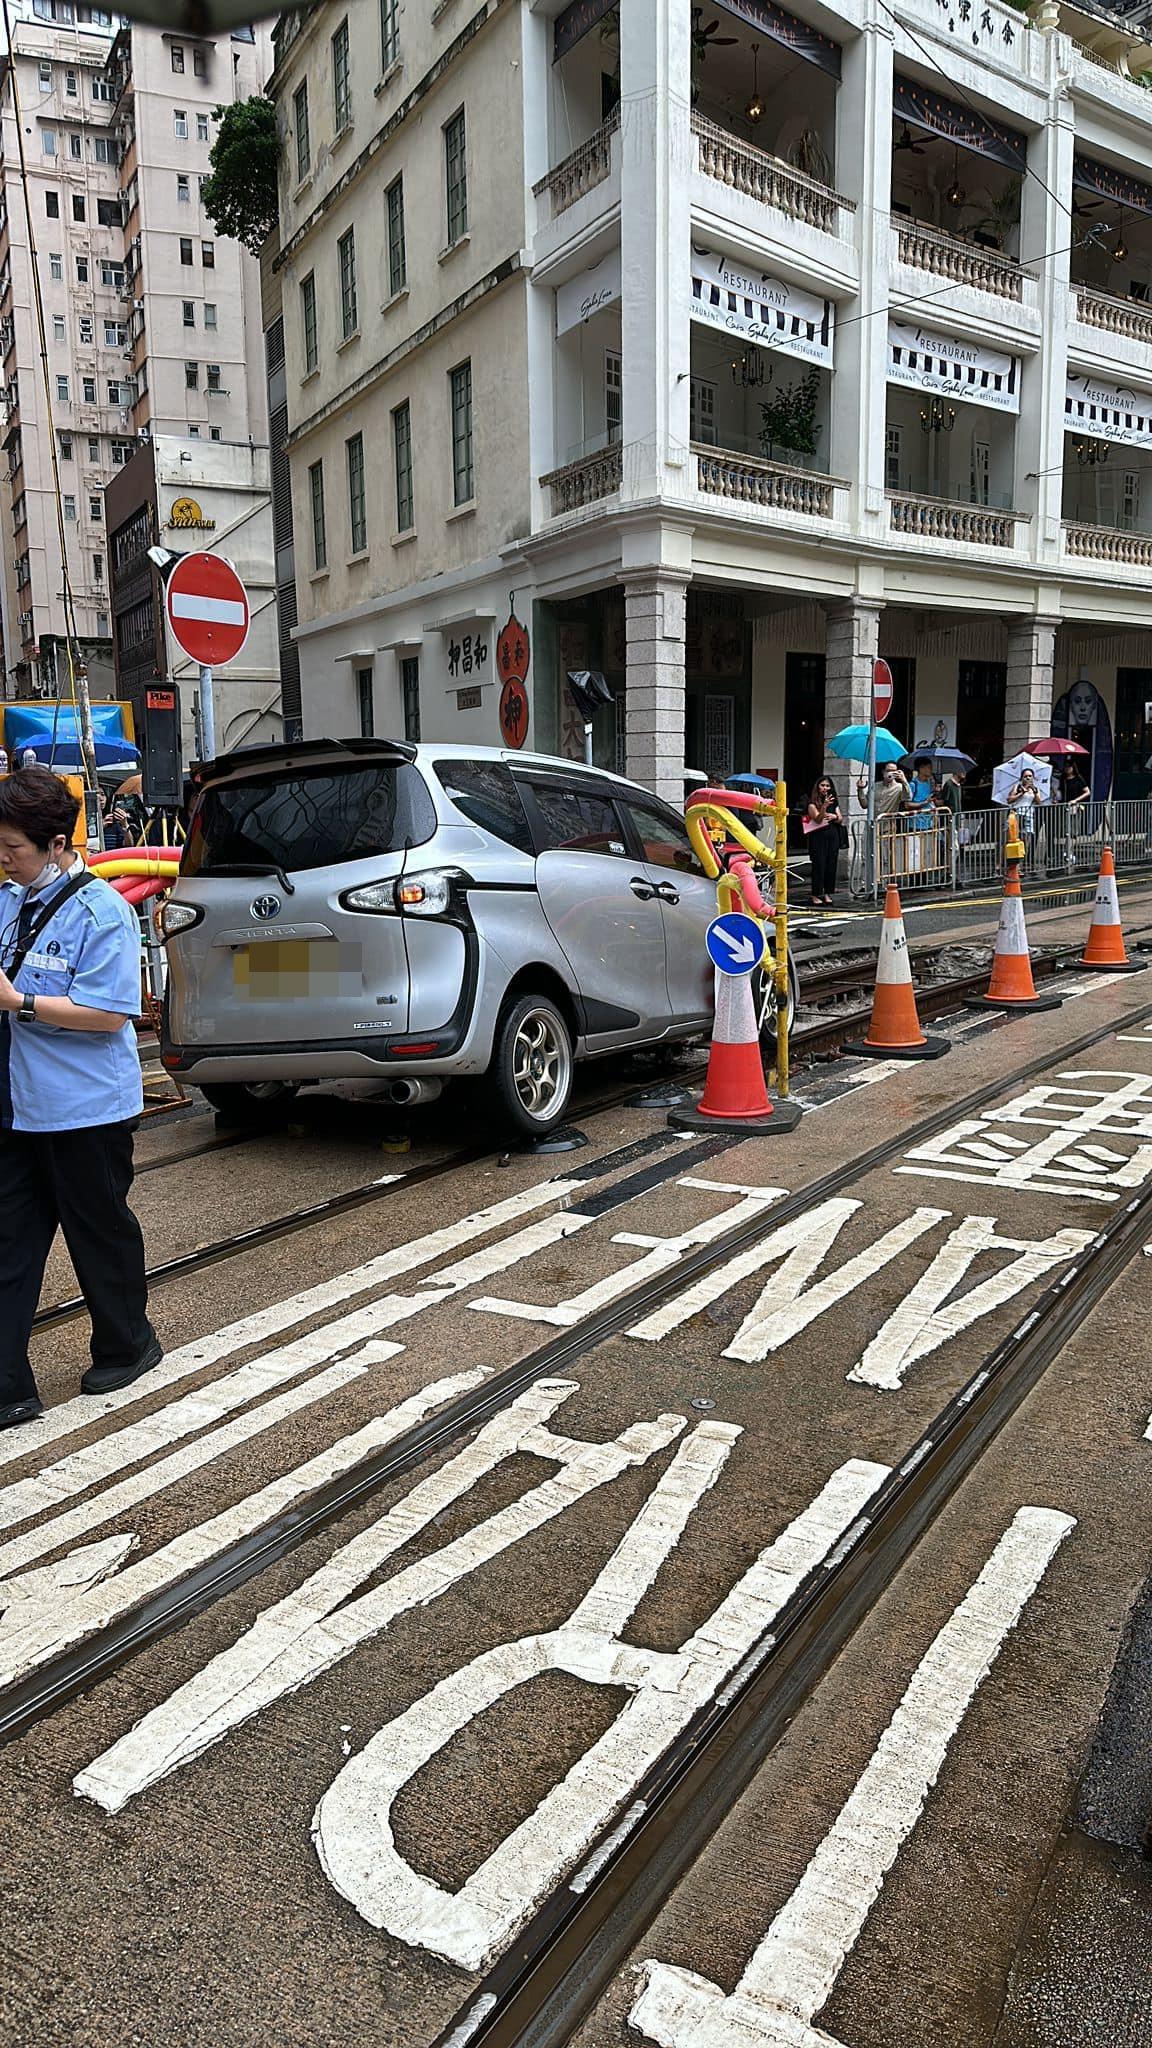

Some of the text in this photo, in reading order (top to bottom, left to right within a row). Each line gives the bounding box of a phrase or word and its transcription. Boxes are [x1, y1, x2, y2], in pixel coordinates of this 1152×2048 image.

[925, 110, 960, 138] MUSIC
[1095, 177, 1125, 201] MUSIC
[723, 272, 788, 307] RESTAURANT
[920, 338, 978, 364] RESTAURANT
[1086, 390, 1136, 411] RESTAURANT
[236, 927, 297, 938] SIENTA
